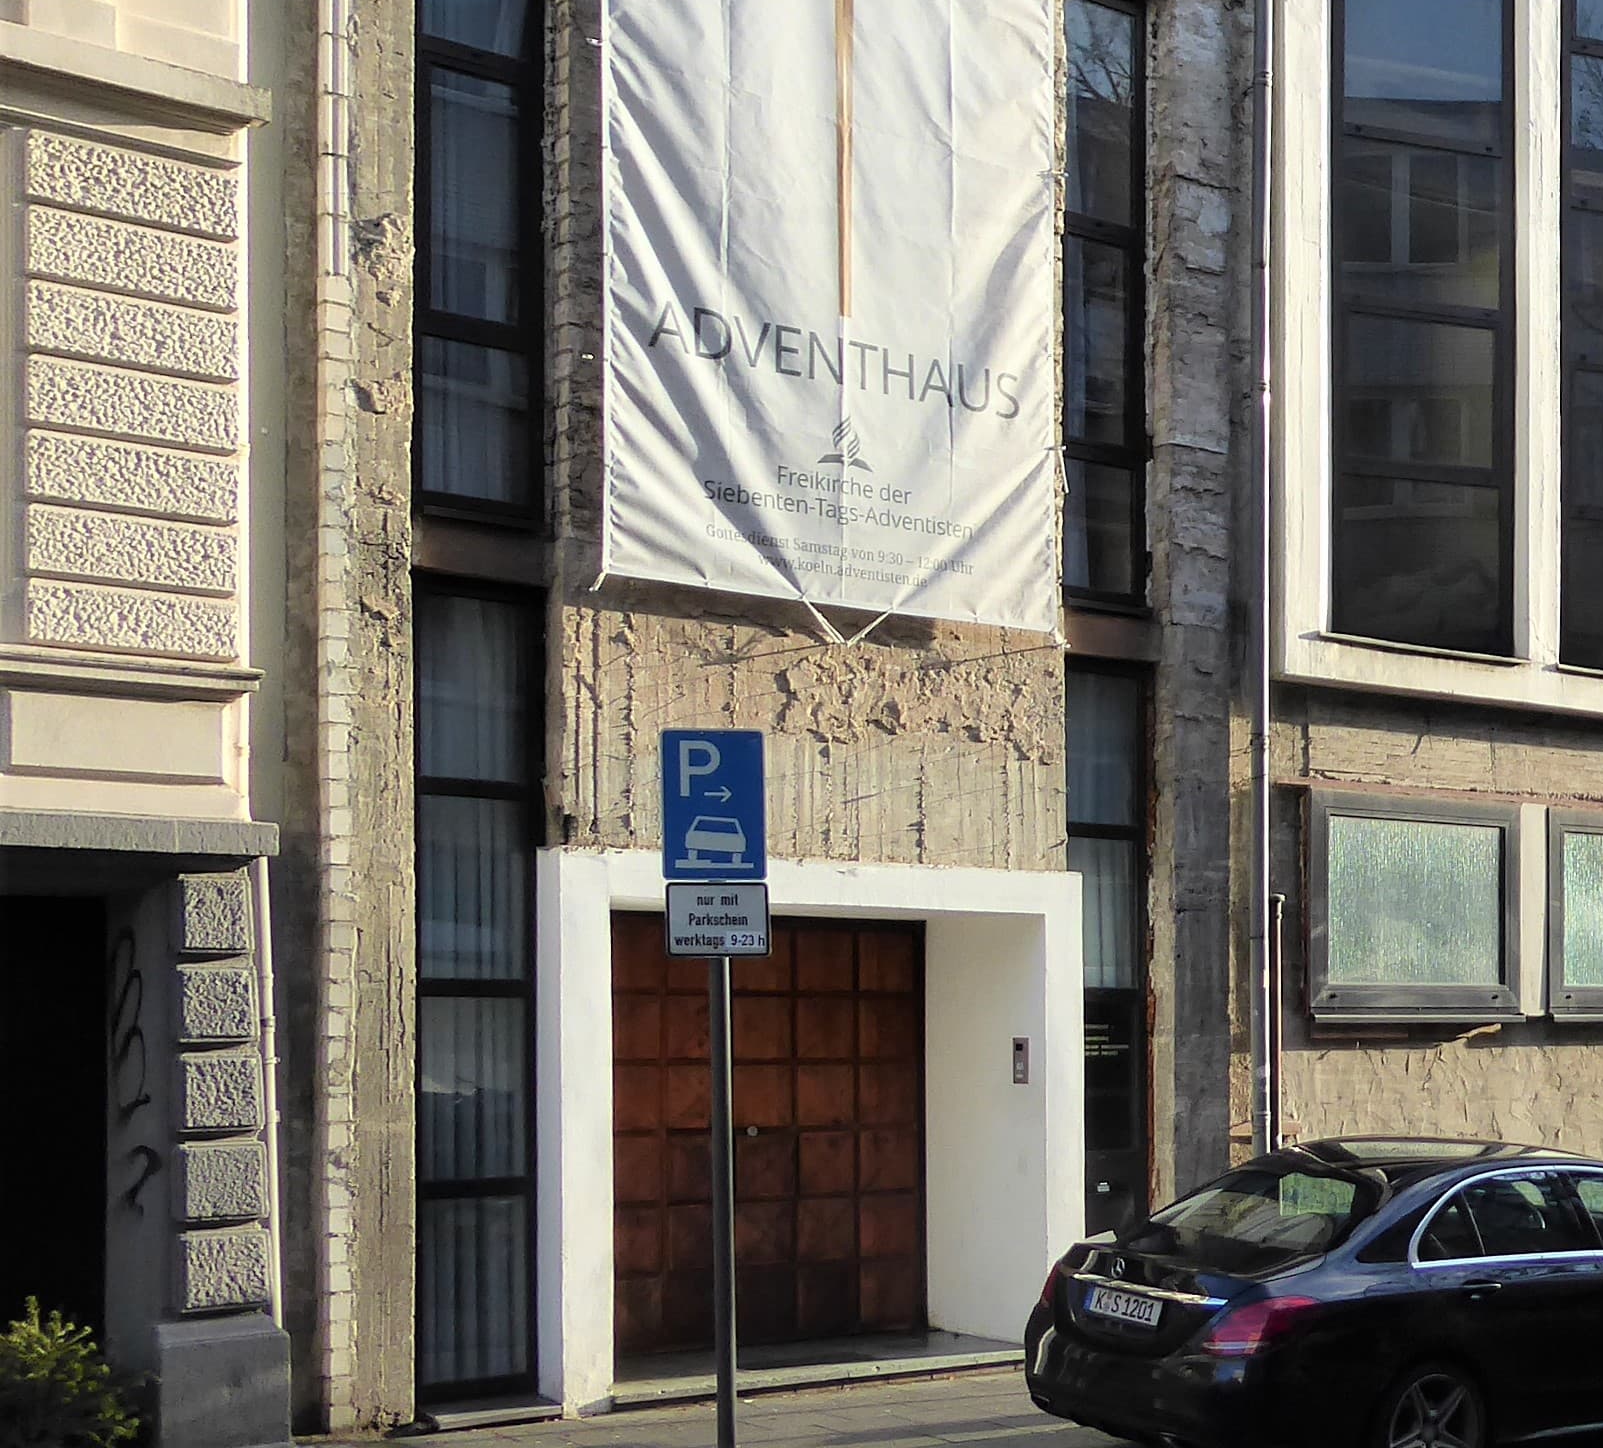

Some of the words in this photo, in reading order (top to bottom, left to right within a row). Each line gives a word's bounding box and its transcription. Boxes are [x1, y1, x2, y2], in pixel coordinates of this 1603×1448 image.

[648, 300, 1020, 420] ADVENTHAUS
[776, 464, 874, 499] Freikirche
[879, 483, 912, 505] der
[703, 479, 974, 540] Siebenten-Tags-Adventisten
[793, 536, 848, 561] Samstag
[851, 547, 875, 562] von
[950, 559, 976, 575] Uhr
[679, 740, 721, 797] P
[688, 913, 749, 926] Parkschein
[696, 896, 715, 906] nur
[720, 894, 739, 906] mit
[674, 933, 726, 949] werktags
[758, 934, 766, 946] h
[1095, 1290, 1107, 1310] K
[1111, 1295, 1122, 1313] S
[1121, 1297, 1154, 1322] 1201
